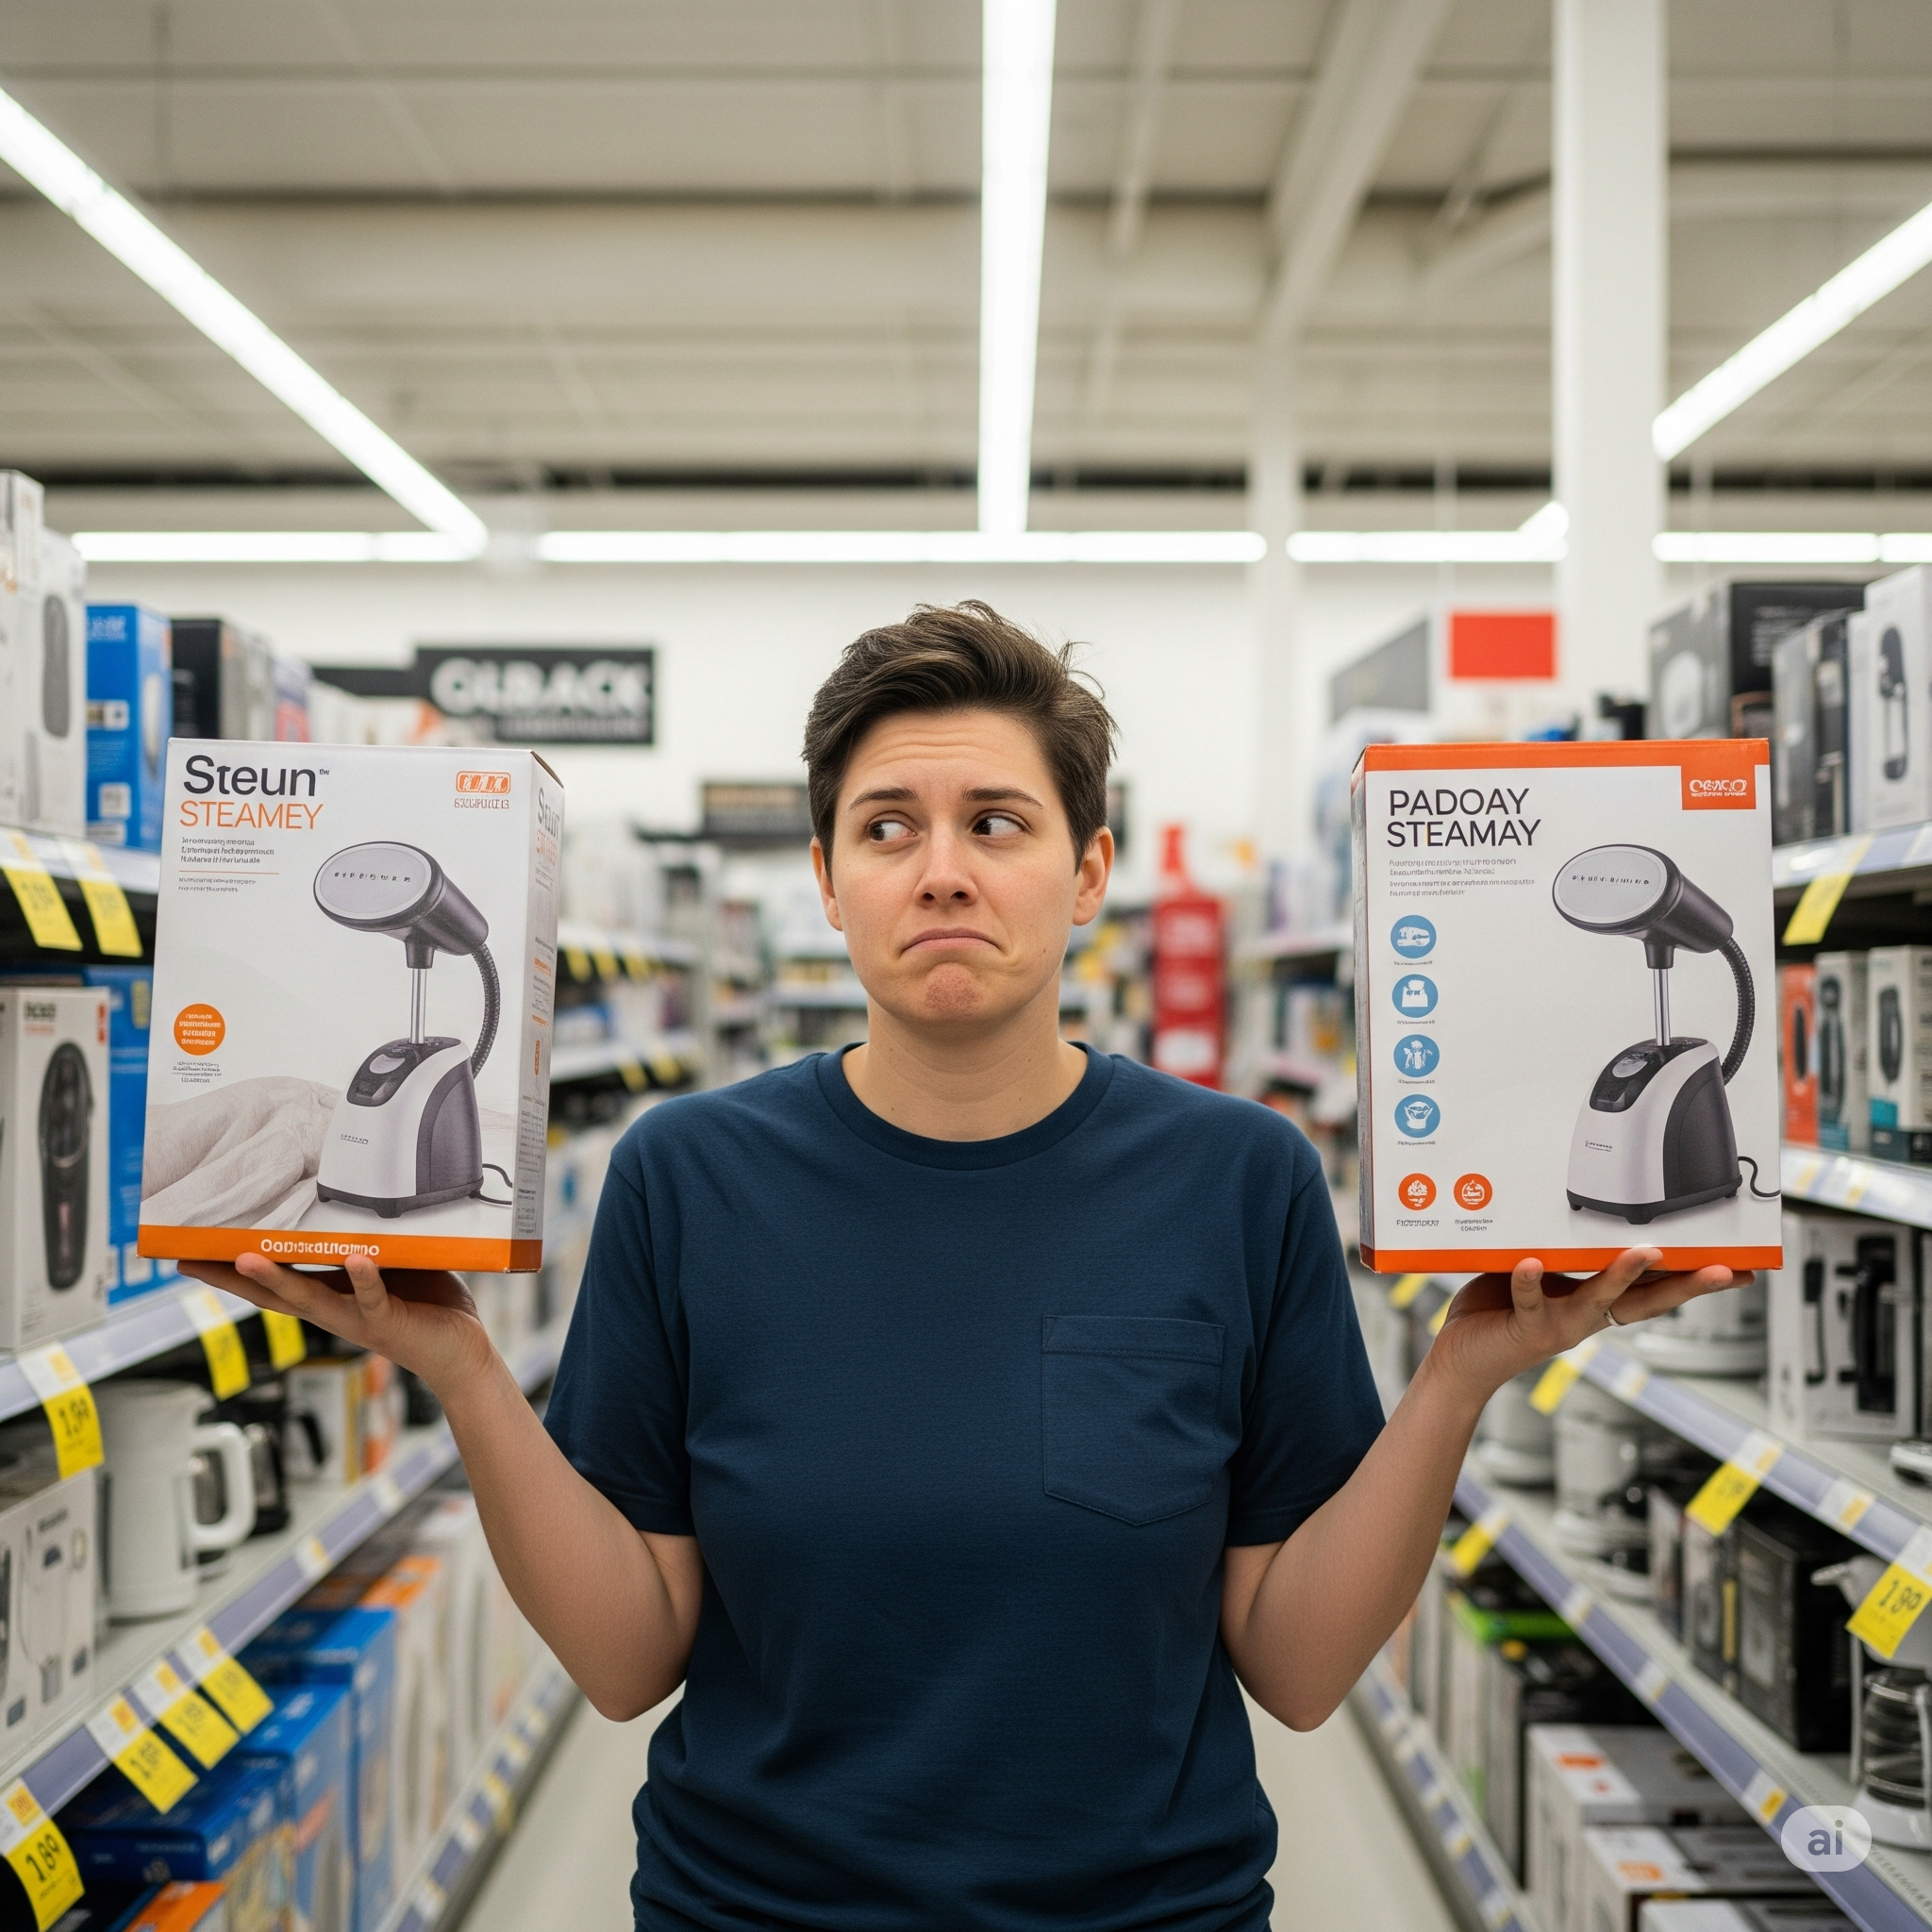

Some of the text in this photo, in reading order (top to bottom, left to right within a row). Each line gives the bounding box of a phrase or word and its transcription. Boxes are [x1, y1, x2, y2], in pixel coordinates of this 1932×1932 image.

[184, 755, 317, 796] Steun
[179, 800, 325, 829] STEAMEY
[1390, 788, 1530, 816] PADOAY
[1387, 819, 1541, 847] STEAMAY
